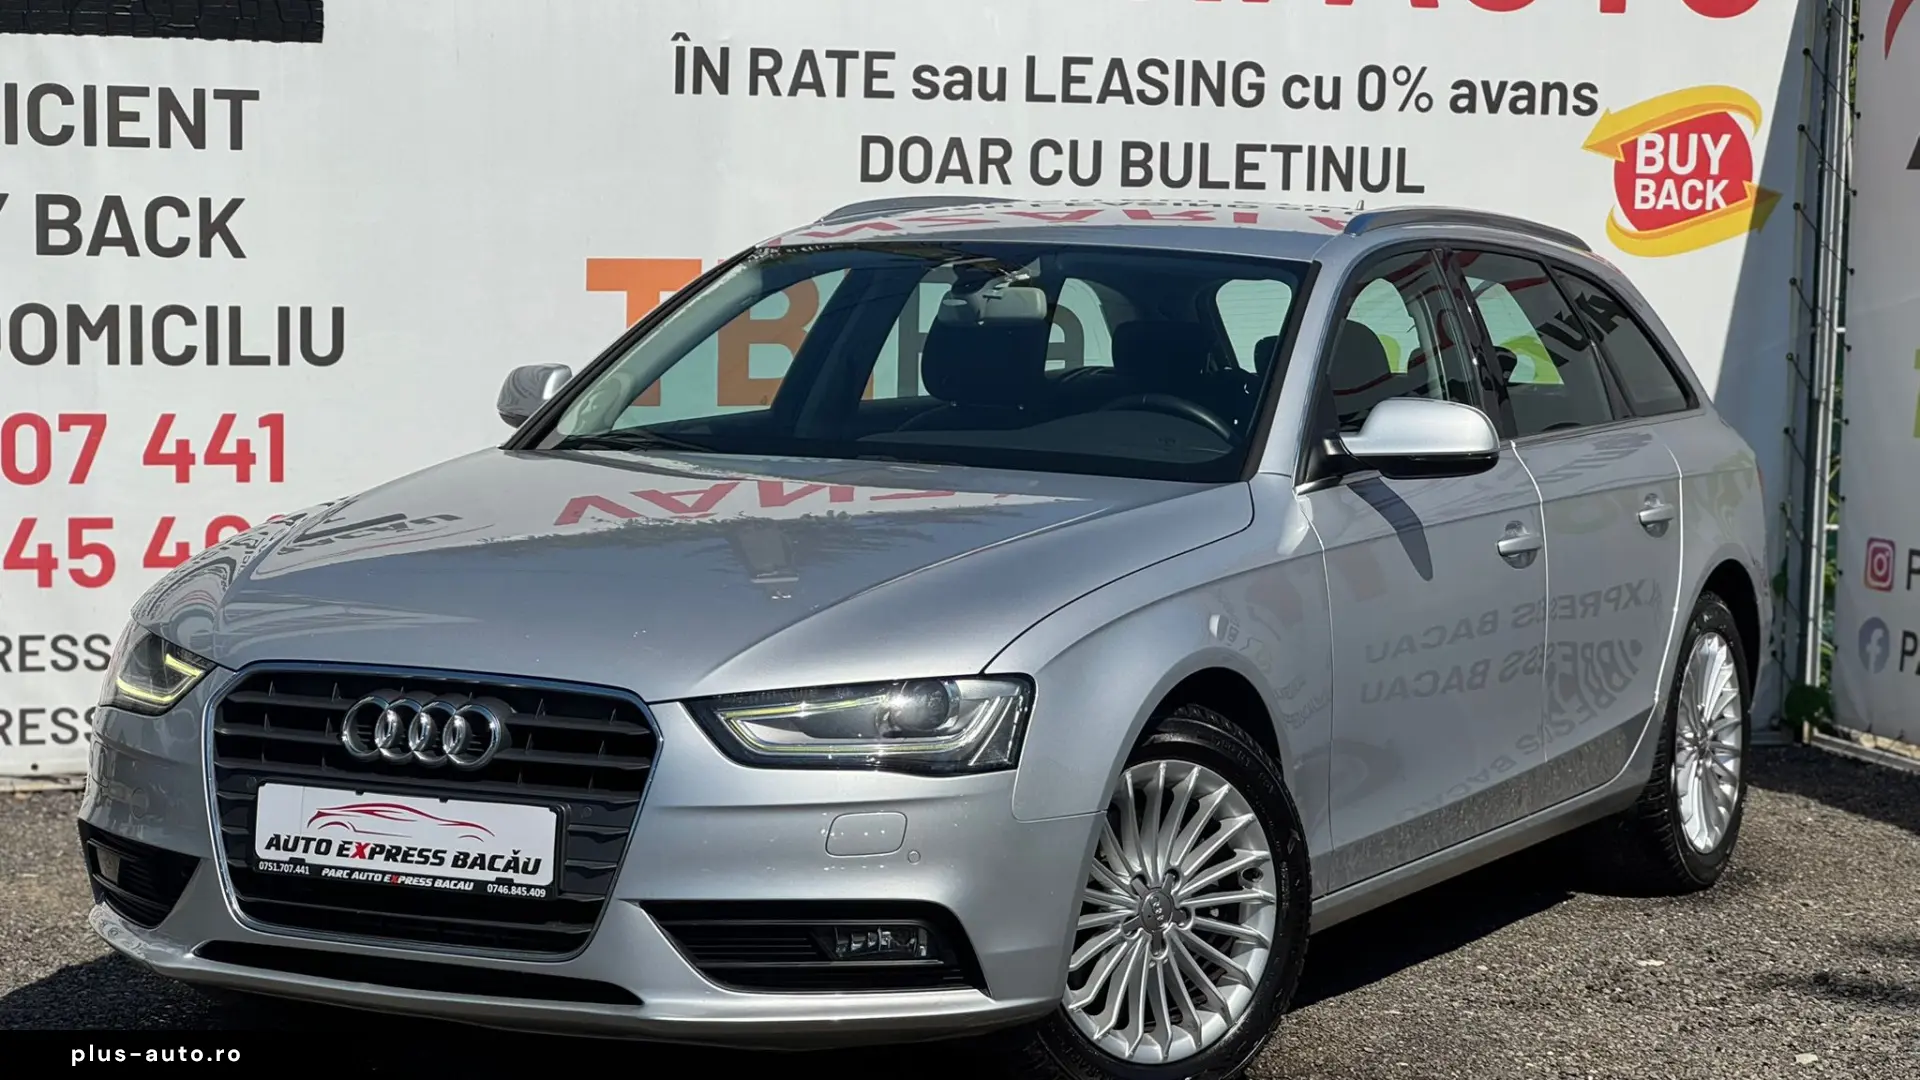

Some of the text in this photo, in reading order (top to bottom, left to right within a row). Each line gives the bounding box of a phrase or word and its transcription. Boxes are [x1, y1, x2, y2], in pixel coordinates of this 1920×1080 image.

[670, 32, 1599, 117] ÎN RATE sau LEASING cu 0% avans
[4, 82, 260, 151] ICIENT
[860, 136, 1425, 194] DOAR CU BULETINUL
[1635, 133, 1732, 175] BUY
[36, 193, 247, 259] BACK
[1634, 178, 1730, 210] BACK
[0, 302, 345, 367] OMICILIU
[0, 412, 285, 486] 07 441
[3, 517, 116, 589] 45
[259, 861, 547, 898] 0751.707.441 PARC AUTO EXPRESS BACAU 0746.845.409
[265, 833, 543, 876] AUTO EXPRESS BACĂU
